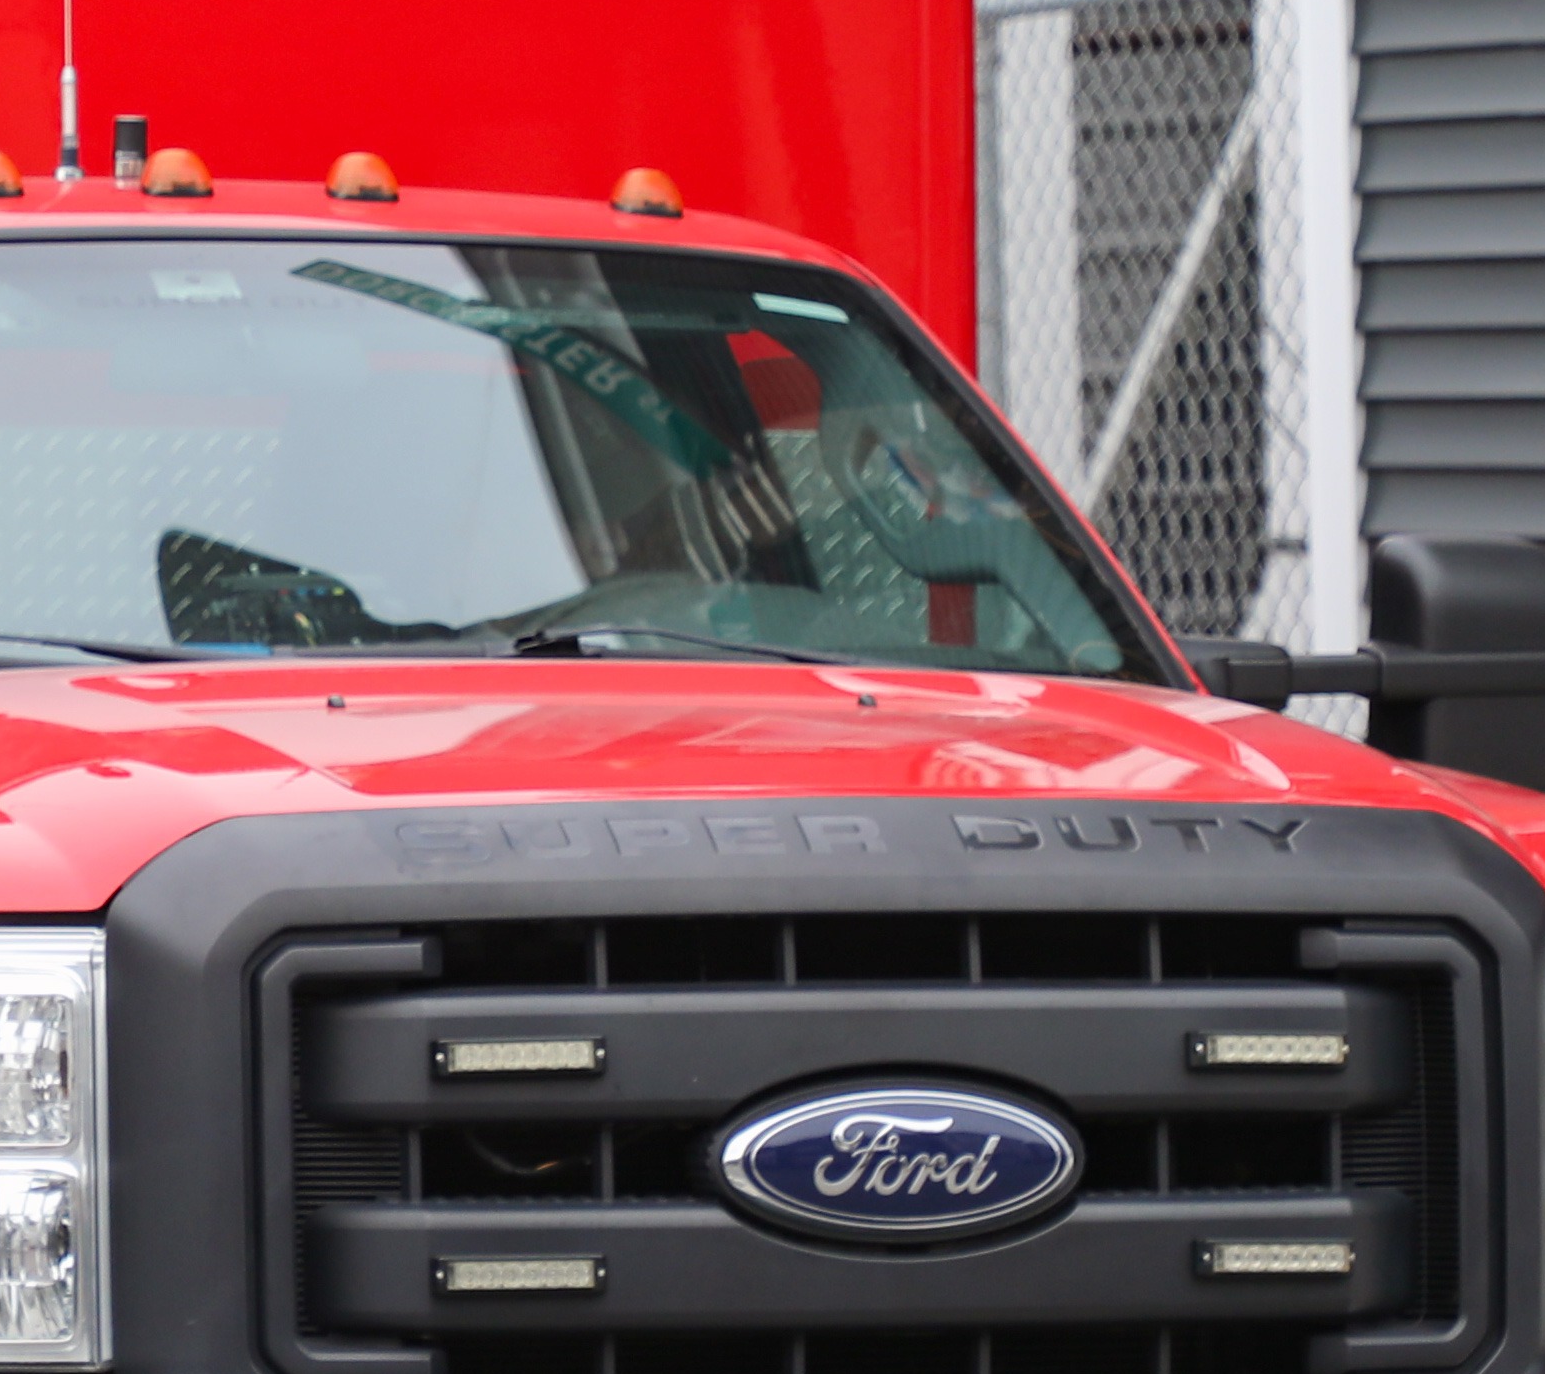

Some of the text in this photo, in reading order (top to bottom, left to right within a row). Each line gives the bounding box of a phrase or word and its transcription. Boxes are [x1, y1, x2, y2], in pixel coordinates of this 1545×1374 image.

[395, 813, 1309, 865] SUPER DUTY
[813, 1113, 1001, 1197] Ford
